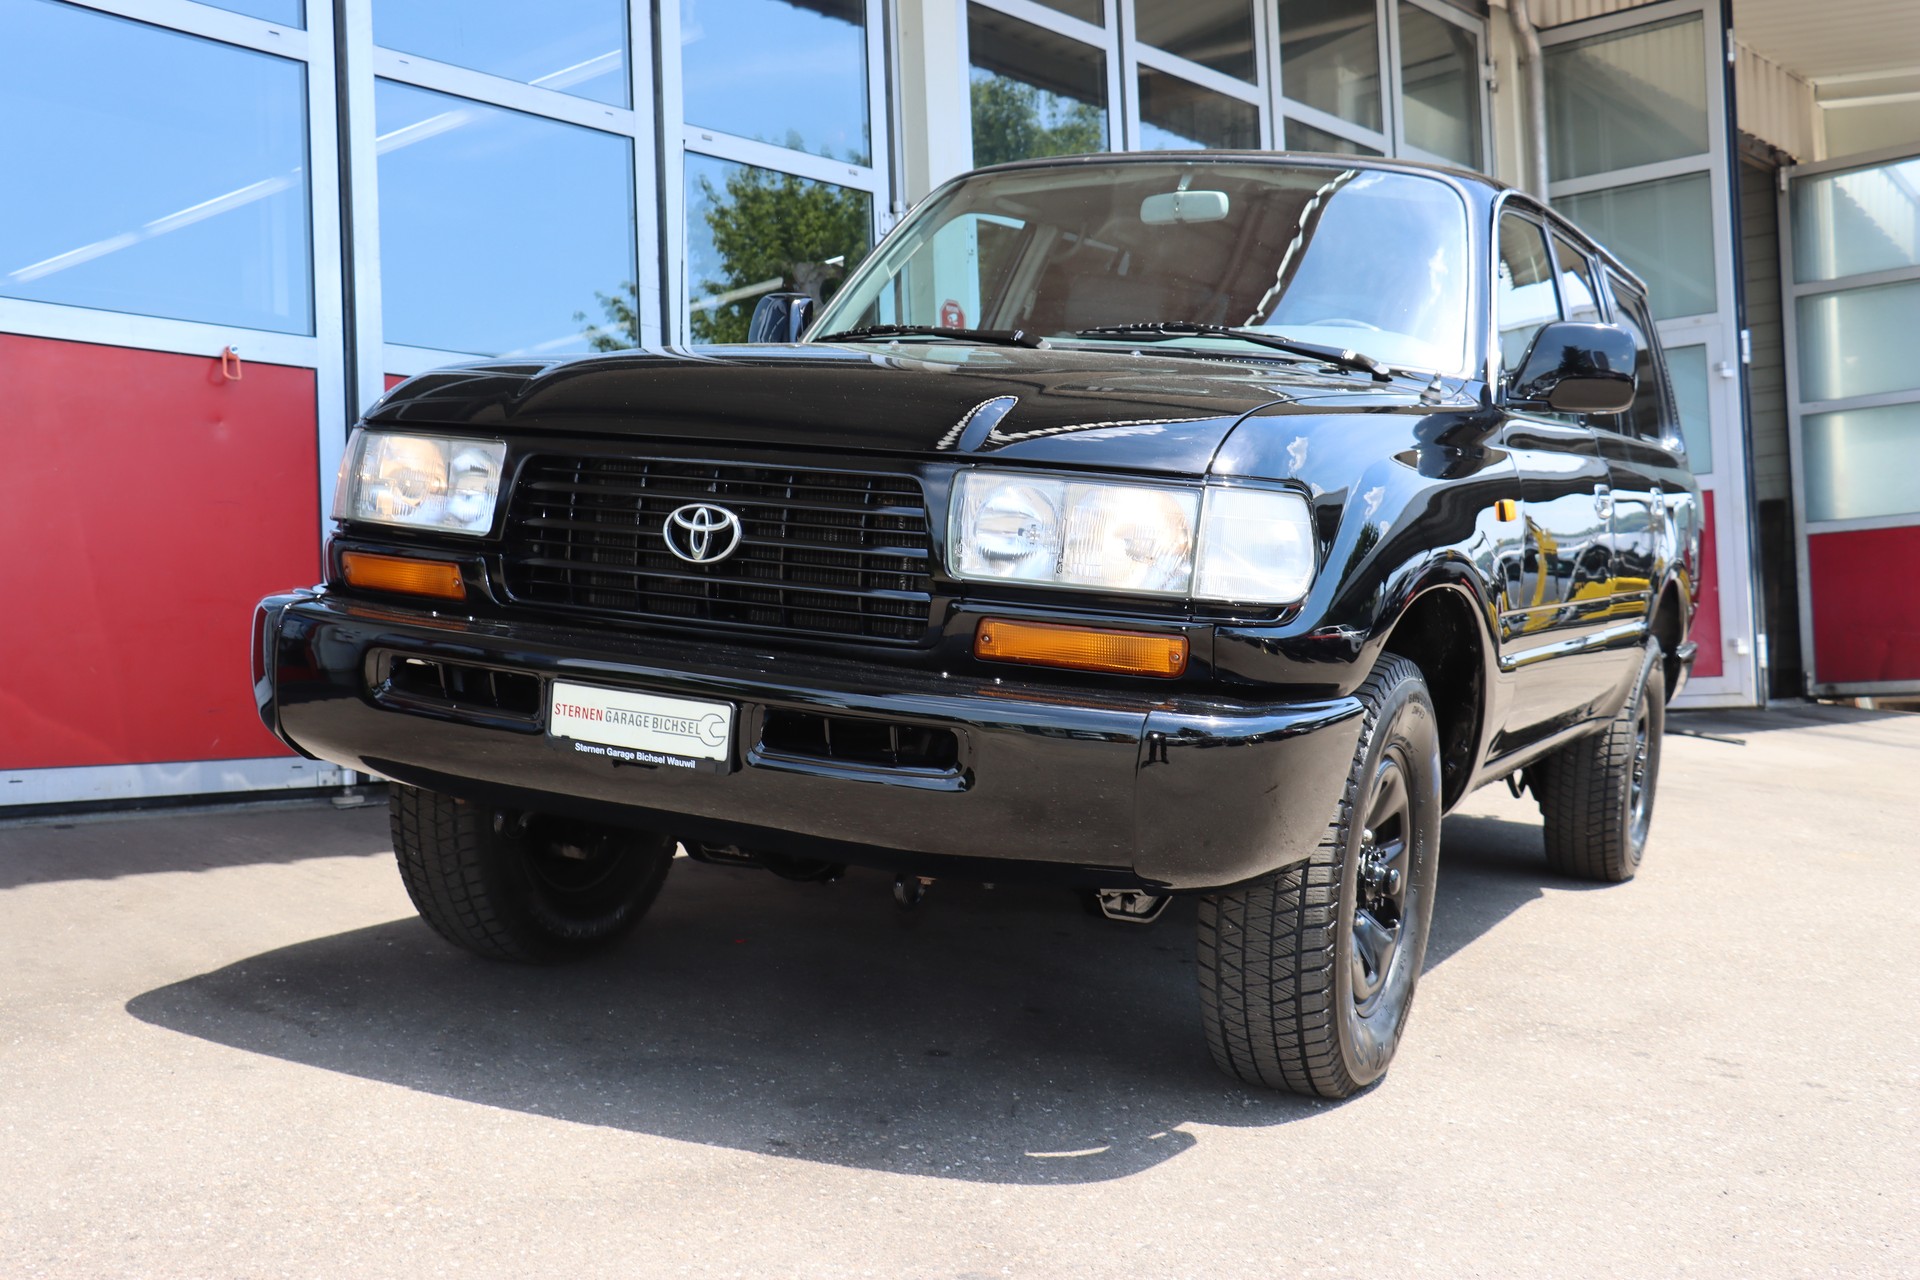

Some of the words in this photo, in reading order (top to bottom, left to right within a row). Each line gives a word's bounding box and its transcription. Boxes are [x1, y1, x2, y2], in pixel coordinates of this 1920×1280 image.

[554, 702, 603, 721] STERNEN
[605, 710, 650, 728] GARAGE
[652, 717, 701, 735] BICHSEL
[574, 742, 605, 755] Sternen
[606, 747, 635, 760] Garage
[636, 751, 666, 764] Bichsel
[667, 756, 696, 769] Wauwil
